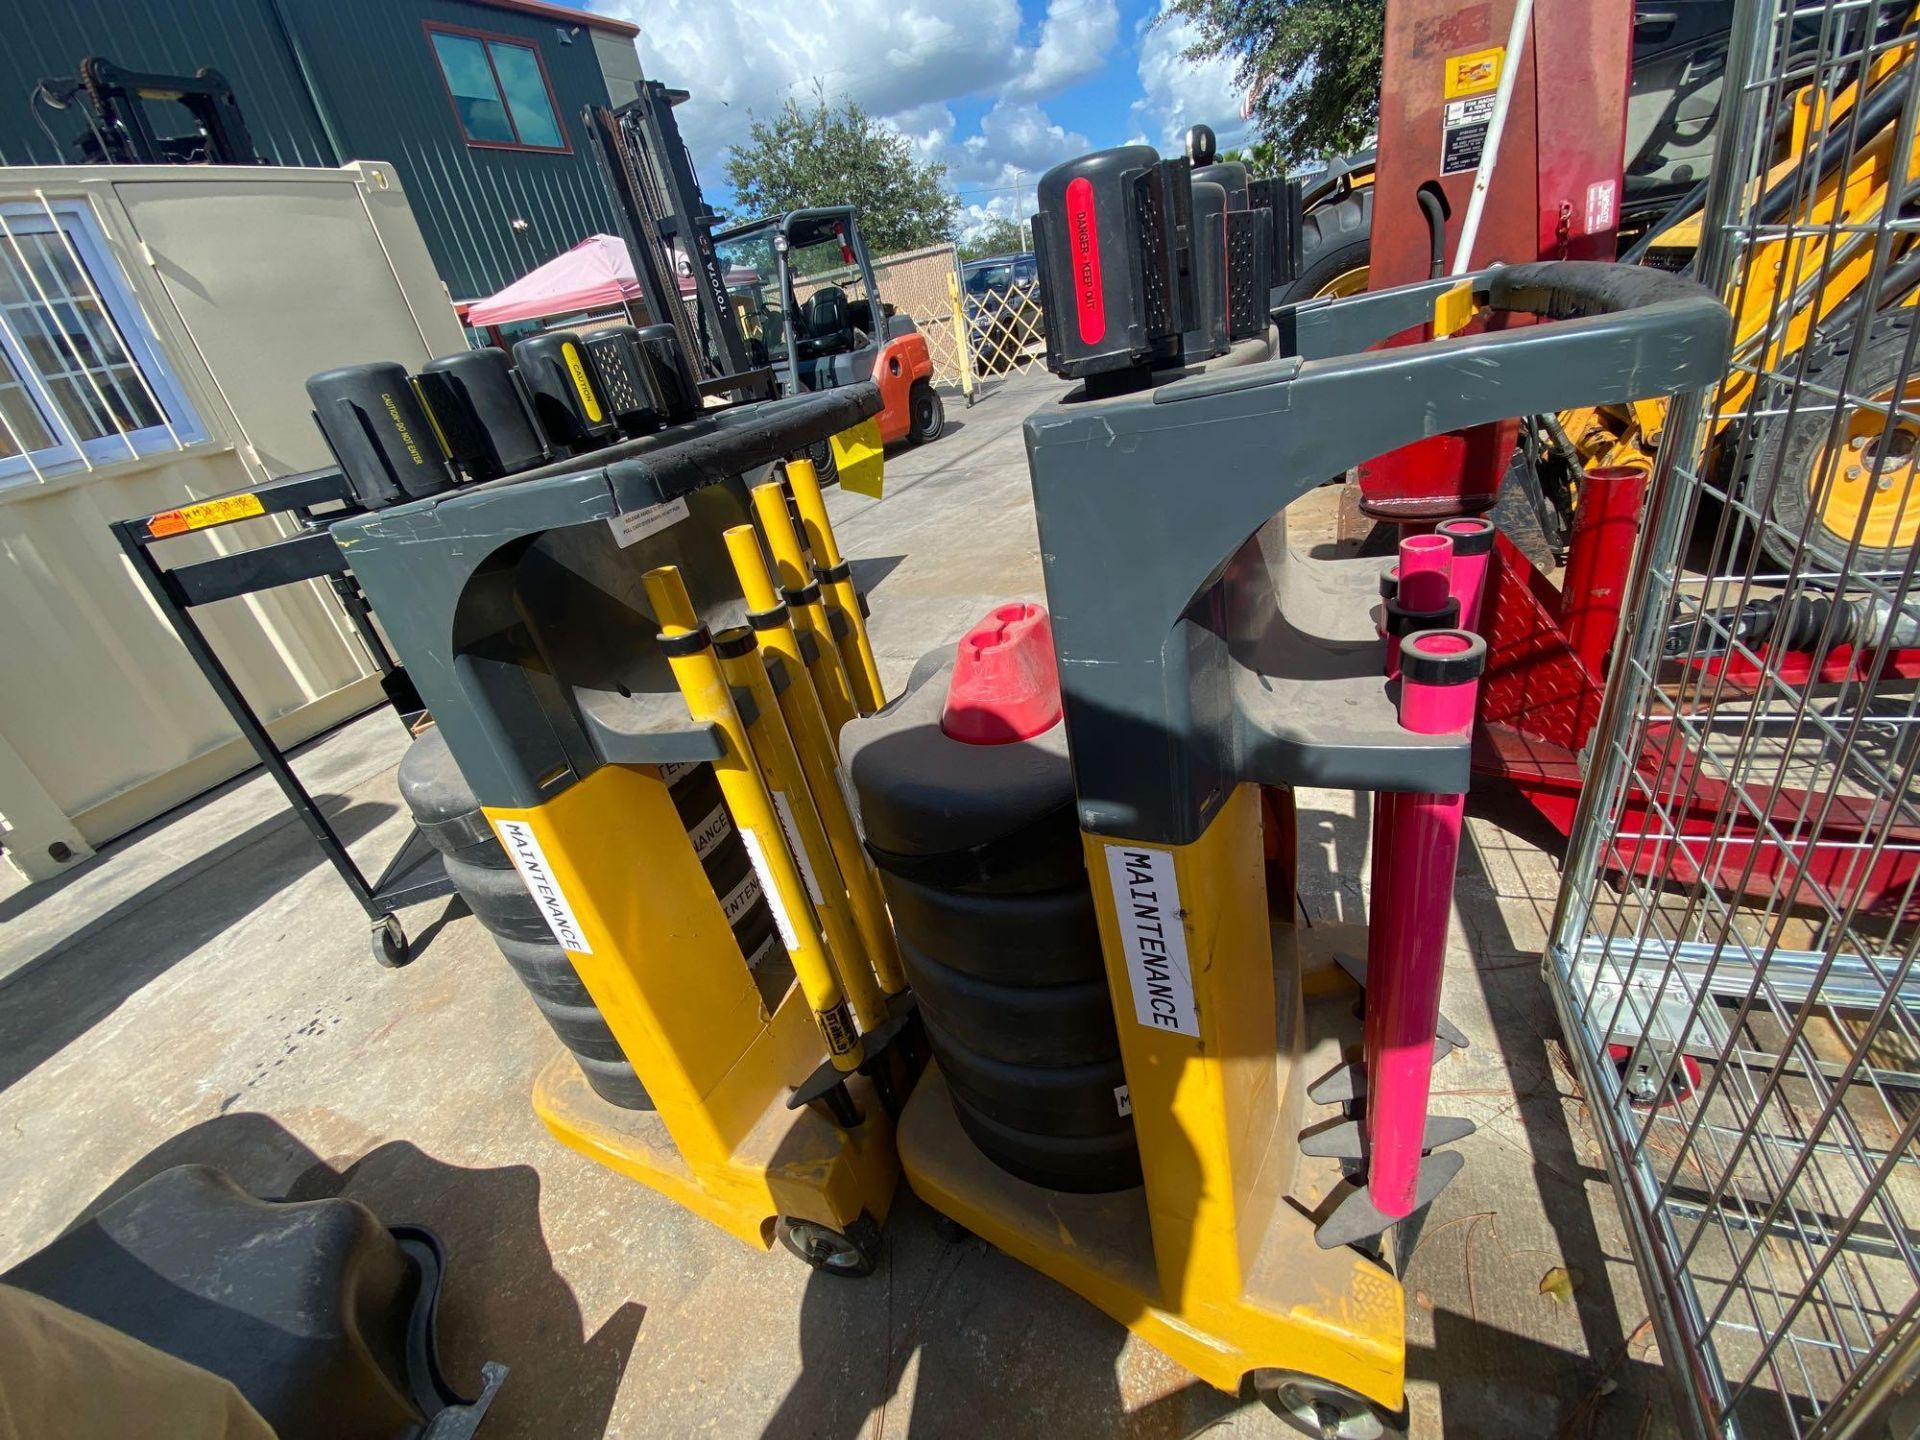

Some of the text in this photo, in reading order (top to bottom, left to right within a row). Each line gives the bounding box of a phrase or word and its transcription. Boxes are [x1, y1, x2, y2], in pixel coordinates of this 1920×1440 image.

[1076, 212, 1089, 256] DANGER
[707, 262, 726, 313] TOYOTA
[1082, 262, 1093, 289] KEEP
[1085, 291, 1095, 310] OUT
[574, 364, 592, 402] CAUTION
[401, 432, 414, 445] NOT
[407, 445, 423, 465] ENTER
[506, 824, 582, 950] MAINTENANCE
[1123, 852, 1179, 1029] MAINTENANCE
